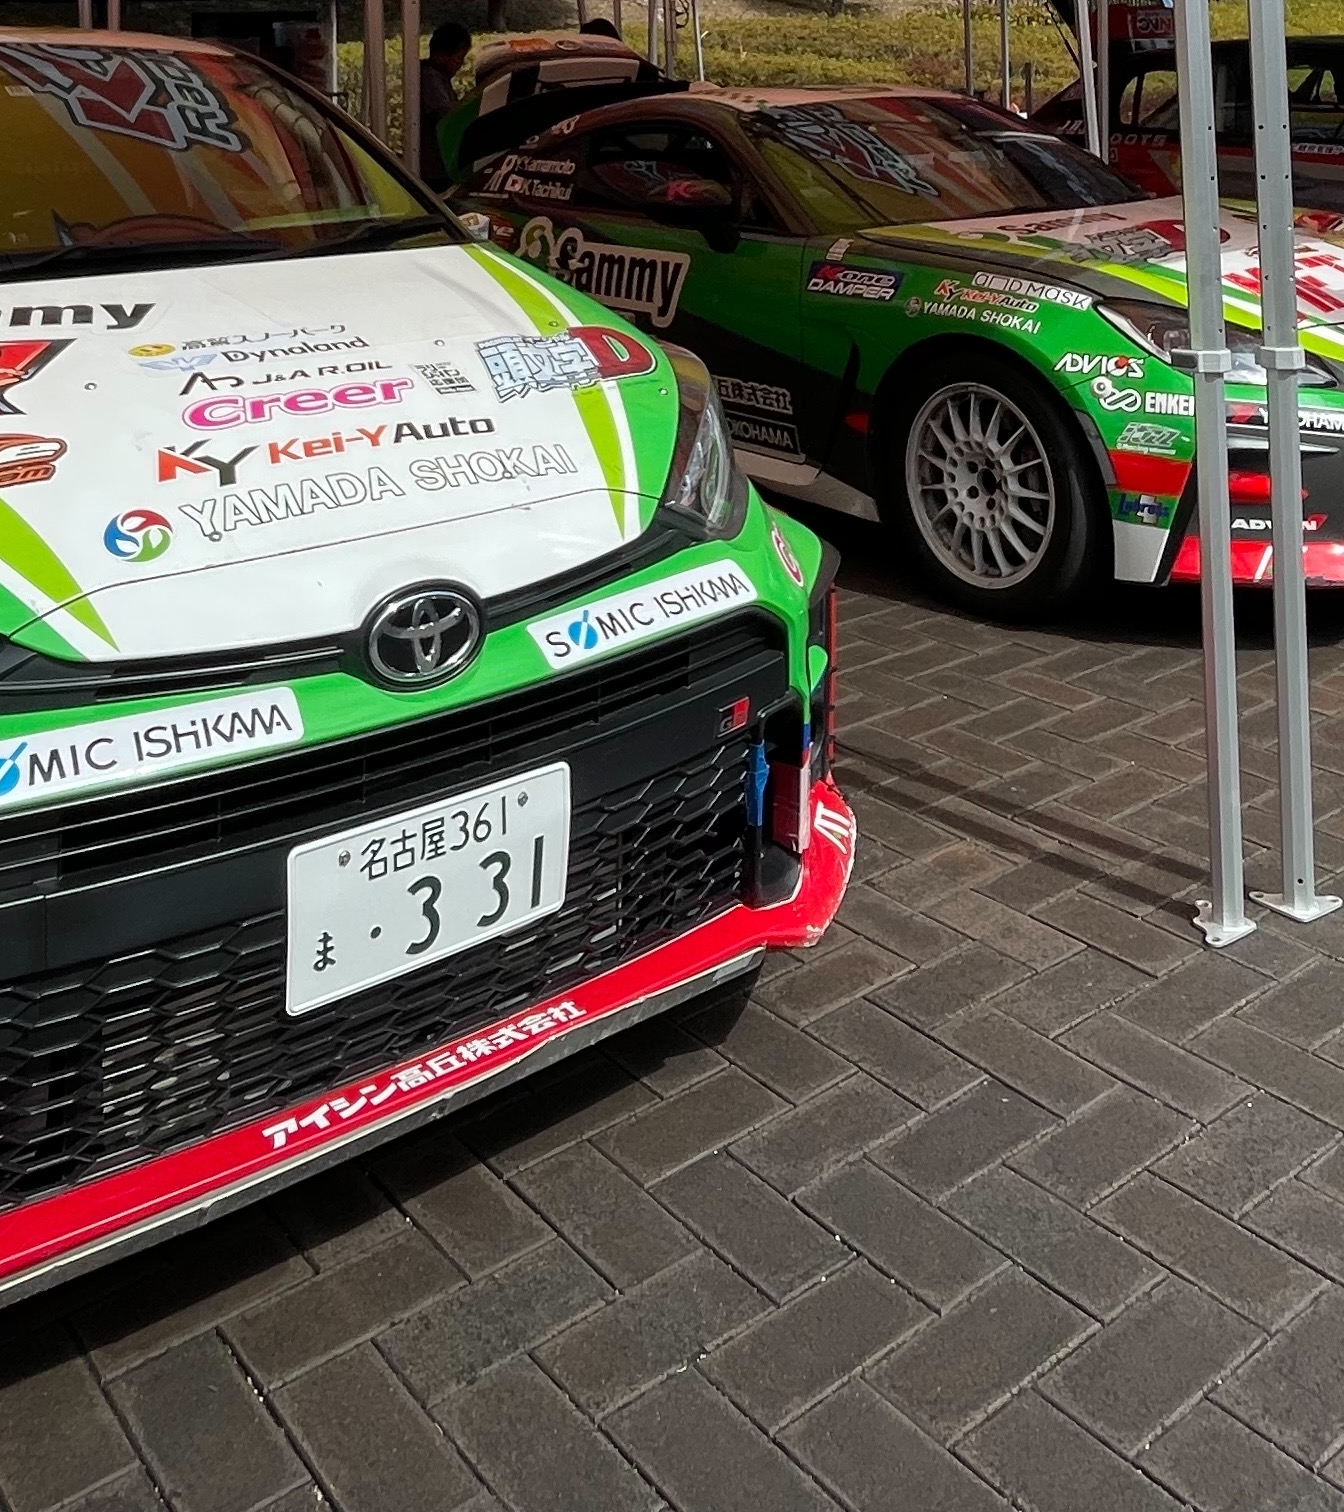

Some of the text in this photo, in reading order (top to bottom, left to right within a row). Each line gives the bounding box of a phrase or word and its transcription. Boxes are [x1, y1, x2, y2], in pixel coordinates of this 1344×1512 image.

[806, 277, 897, 301] DAMPER
[923, 301, 1042, 335] YAMADA SHOKAI
[221, 335, 370, 364] Dynaland
[186, 378, 413, 428] Creer
[1145, 391, 1195, 416] ENKEI
[392, 416, 497, 446] Auto
[178, 443, 579, 538] YAMADA SHOKAI
[359, 795, 509, 881] 名古屋361
[312, 931, 337, 972] ま
[261, 999, 588, 1150] アイシン高丘株式会社
